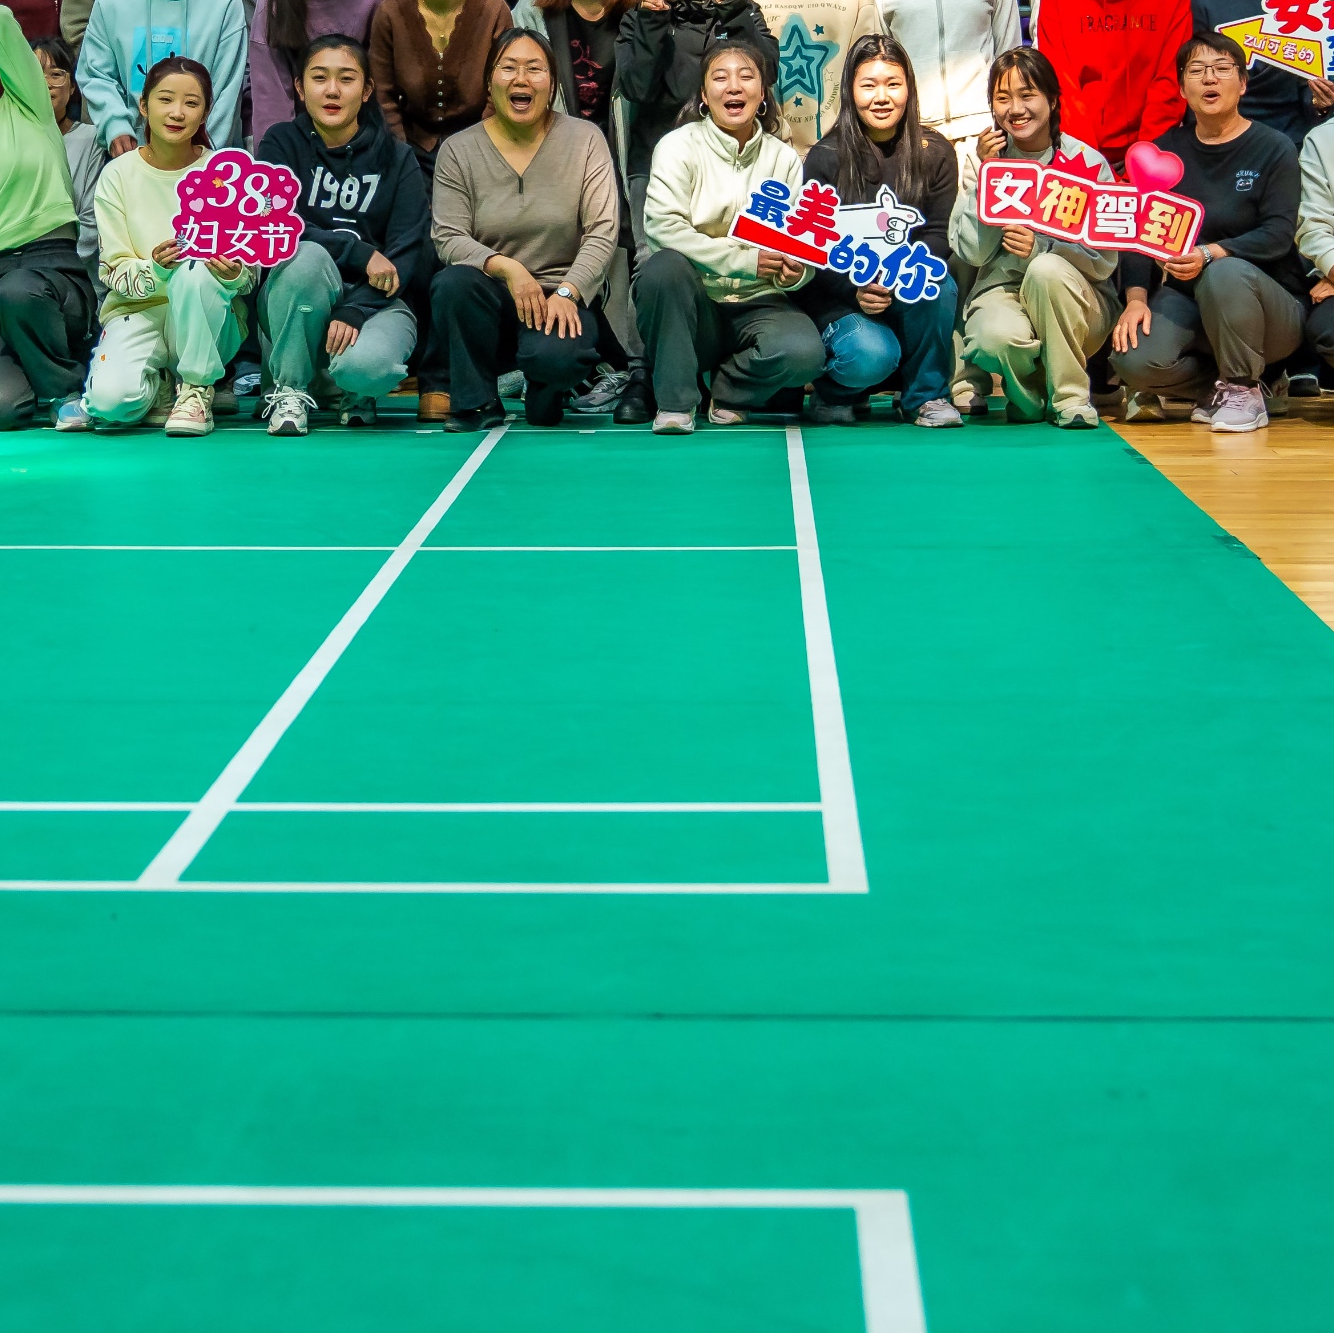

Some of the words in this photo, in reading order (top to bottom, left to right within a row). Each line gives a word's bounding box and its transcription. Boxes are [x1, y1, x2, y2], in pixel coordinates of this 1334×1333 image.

[207, 161, 271, 216] 38
[308, 166, 382, 213] 1987
[989, 171, 1193, 253] 女神驾到
[179, 216, 295, 259] 妇女节
